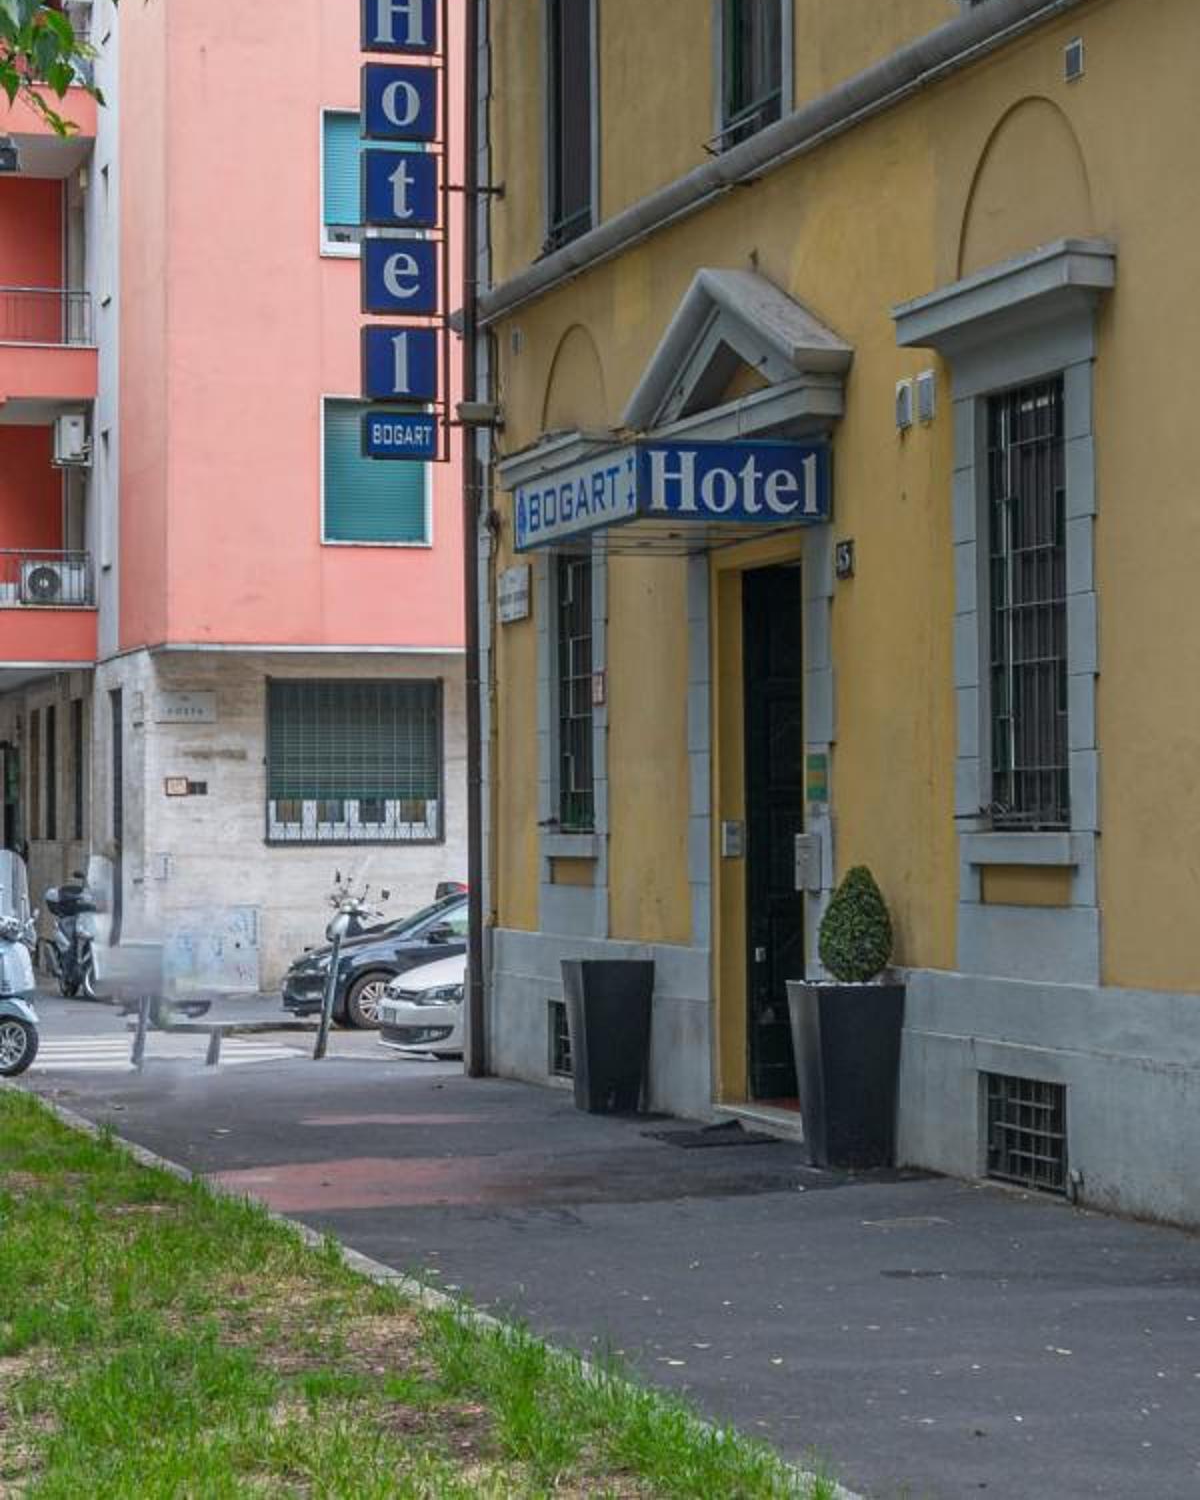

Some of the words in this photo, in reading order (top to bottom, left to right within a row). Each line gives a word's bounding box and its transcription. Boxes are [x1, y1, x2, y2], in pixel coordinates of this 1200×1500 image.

[373, 424, 432, 446] BOGART
[529, 466, 620, 532] BOGART
[648, 451, 818, 514] Hotel
